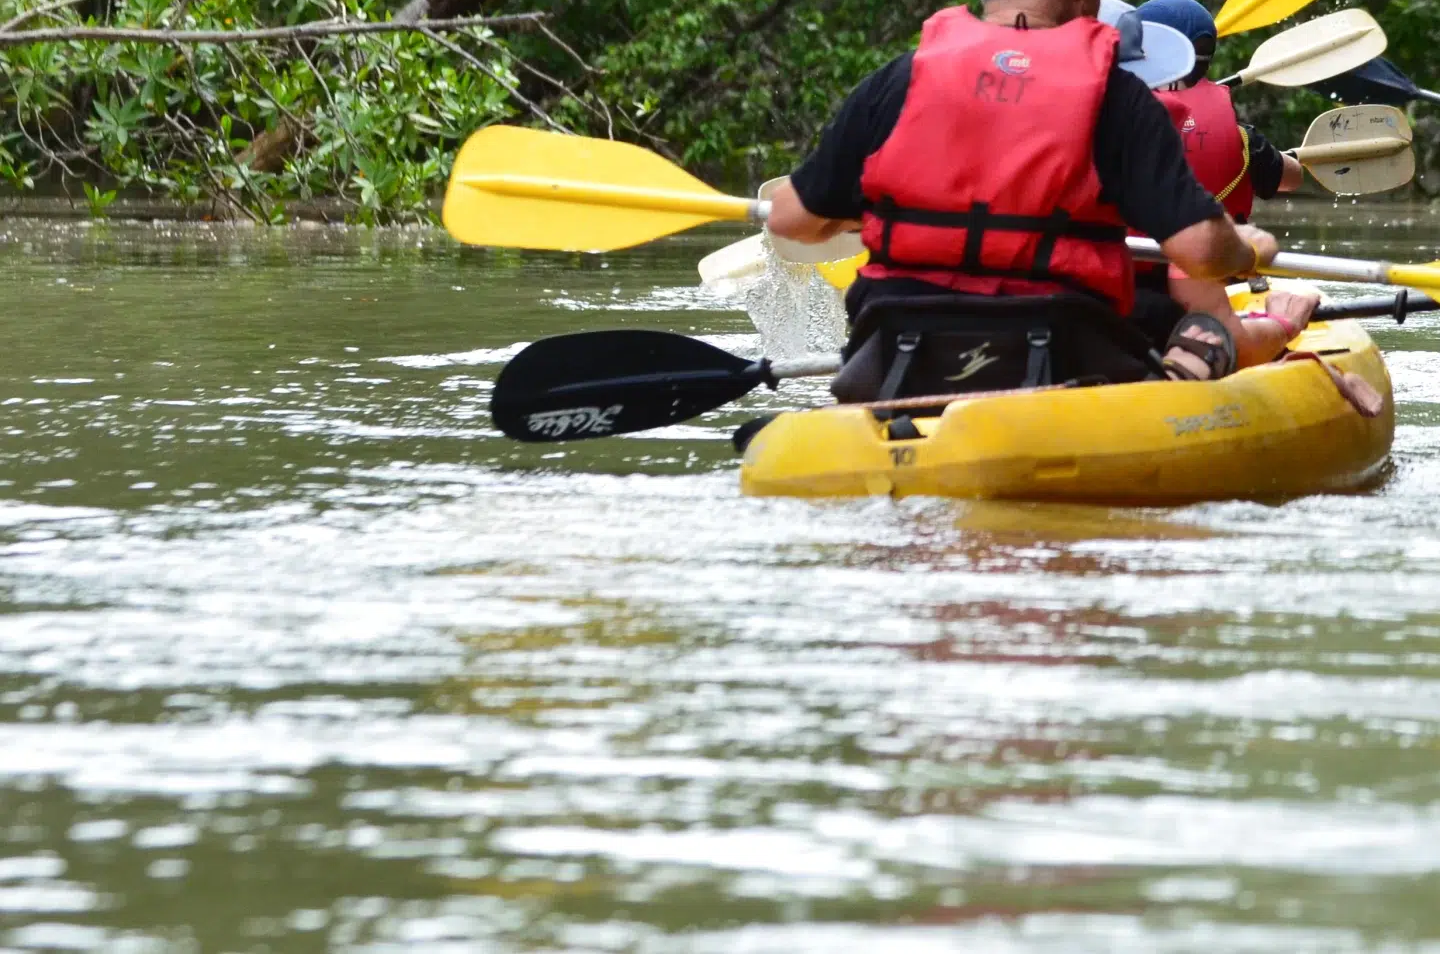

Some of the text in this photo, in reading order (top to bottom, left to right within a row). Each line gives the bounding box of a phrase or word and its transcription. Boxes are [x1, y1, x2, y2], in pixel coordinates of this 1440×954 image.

[974, 71, 1036, 105] RLT
[1183, 131, 1208, 153] LT
[527, 404, 624, 437] Hobie
